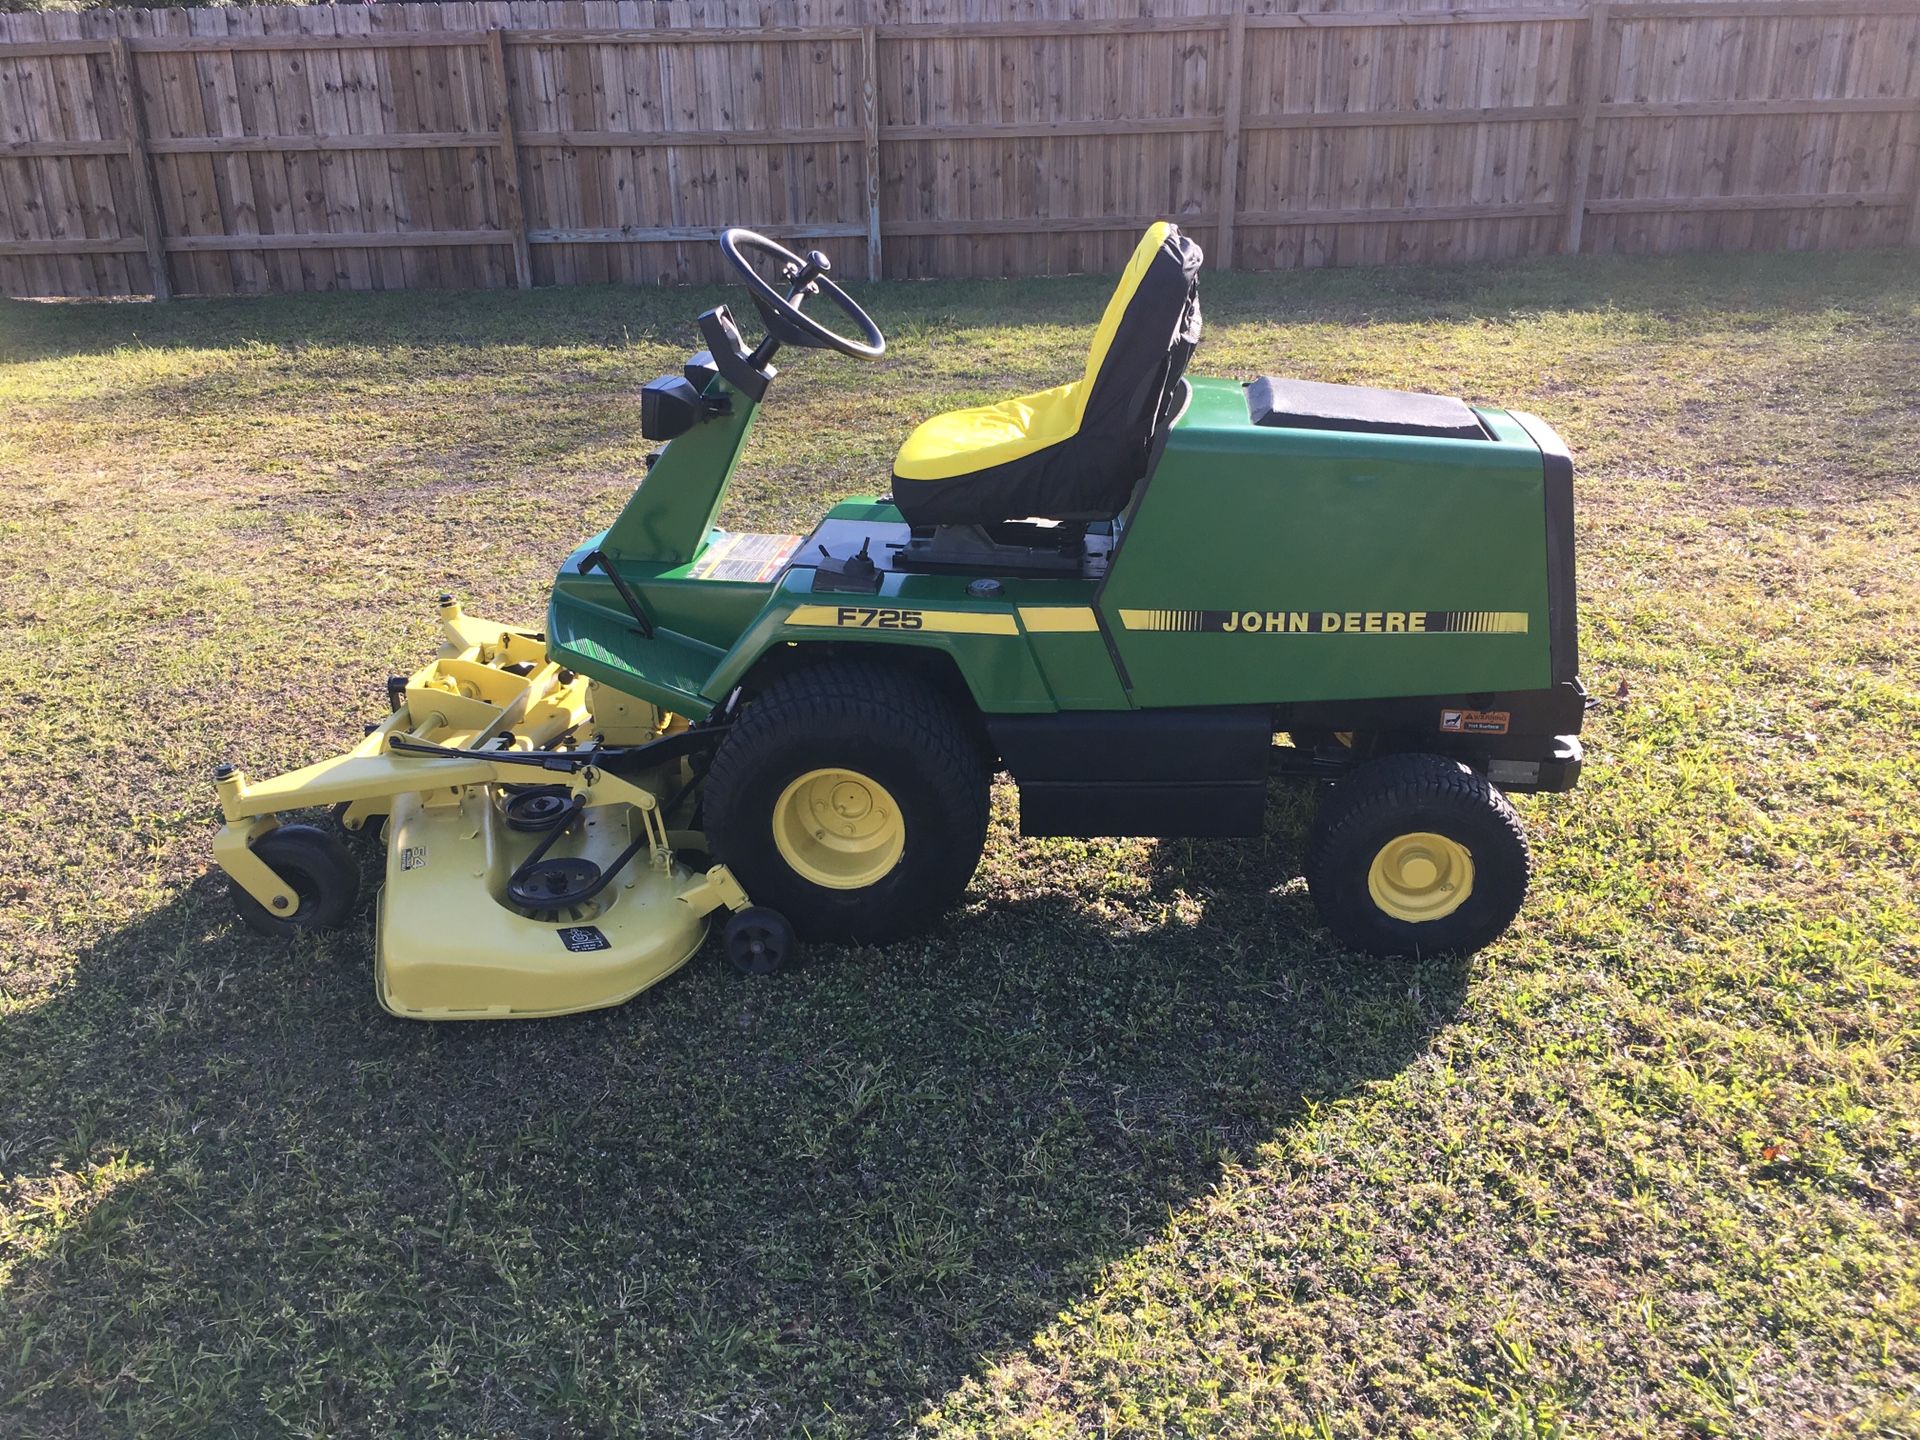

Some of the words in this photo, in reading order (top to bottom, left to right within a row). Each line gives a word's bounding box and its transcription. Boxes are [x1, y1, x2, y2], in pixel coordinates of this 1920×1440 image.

[837, 607, 923, 630] F725
[1222, 611, 1309, 633] JOHN
[1320, 611, 1427, 632] DEERE
[411, 846, 426, 870] 54
